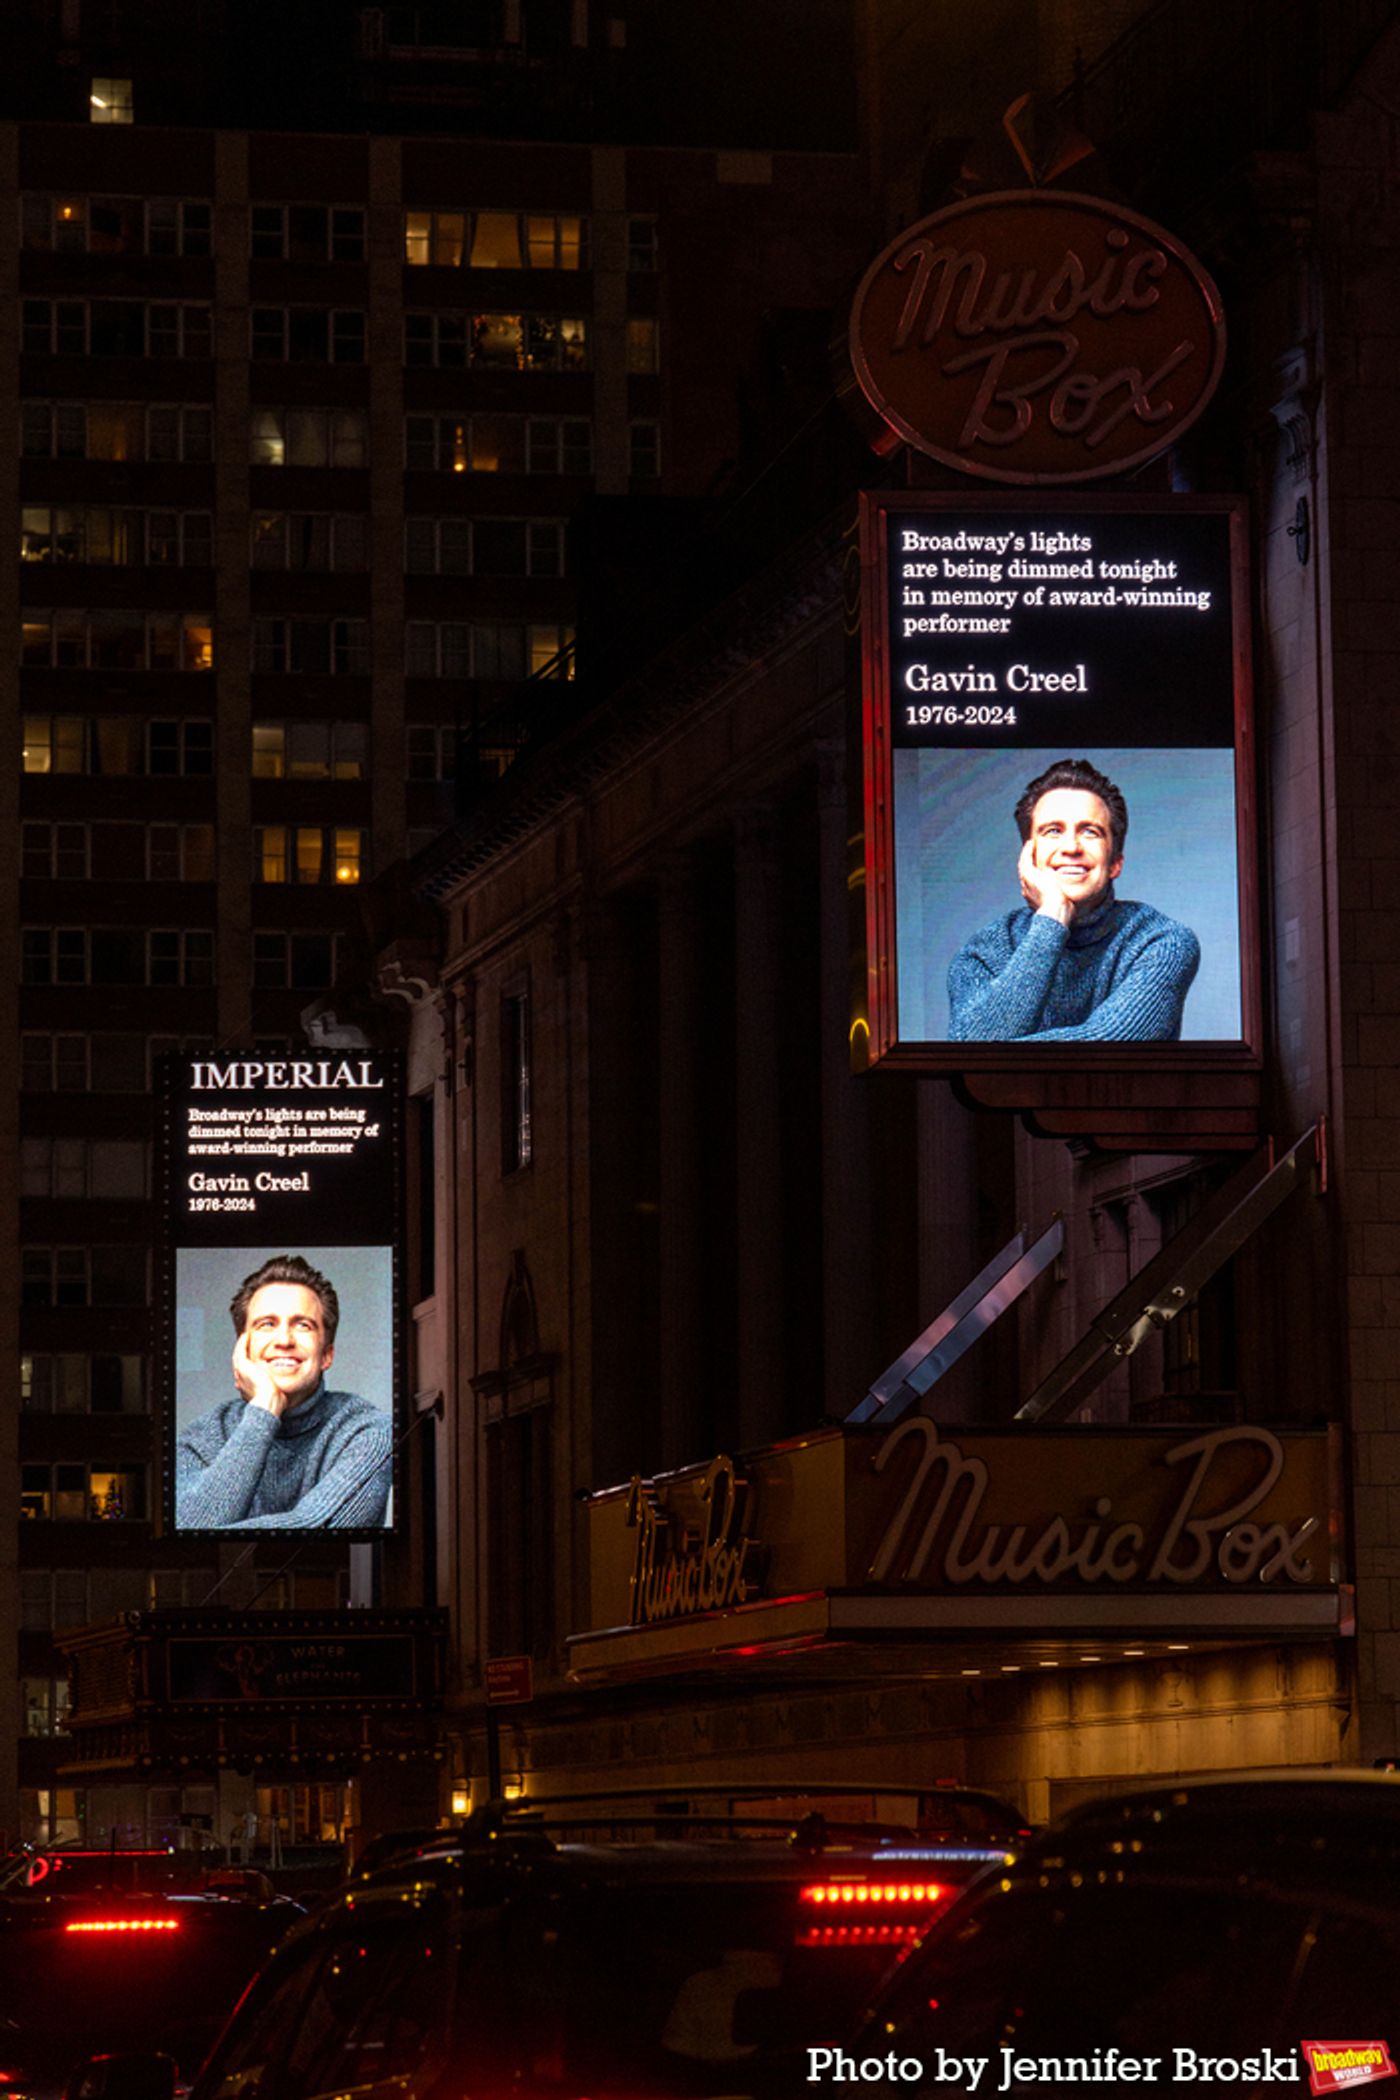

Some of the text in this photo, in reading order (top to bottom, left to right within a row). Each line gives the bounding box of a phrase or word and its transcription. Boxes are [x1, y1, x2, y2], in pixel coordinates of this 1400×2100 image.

[894, 227, 1168, 350] Music
[941, 330, 1195, 450] Box
[901, 531, 1092, 556] Broadway's lights
[902, 557, 1178, 584] are being dimmed tonight
[902, 585, 1212, 611] in memory of award-winning
[903, 612, 1012, 638] performer
[904, 663, 1089, 692] Gavin Creel
[906, 705, 1017, 725] 1976-2024
[190, 1060, 384, 1089] IMPERIAL
[187, 1107, 367, 1124] Broadway's lights are being
[187, 1123, 380, 1140] dimmed tonight in memory of
[187, 1141, 354, 1157] award-winning performer
[188, 1171, 310, 1192] Gavin Creel
[188, 1197, 256, 1212] 1976-2024
[868, 1415, 1321, 1584] Music Box
[289, 1645, 346, 1659] WATER
